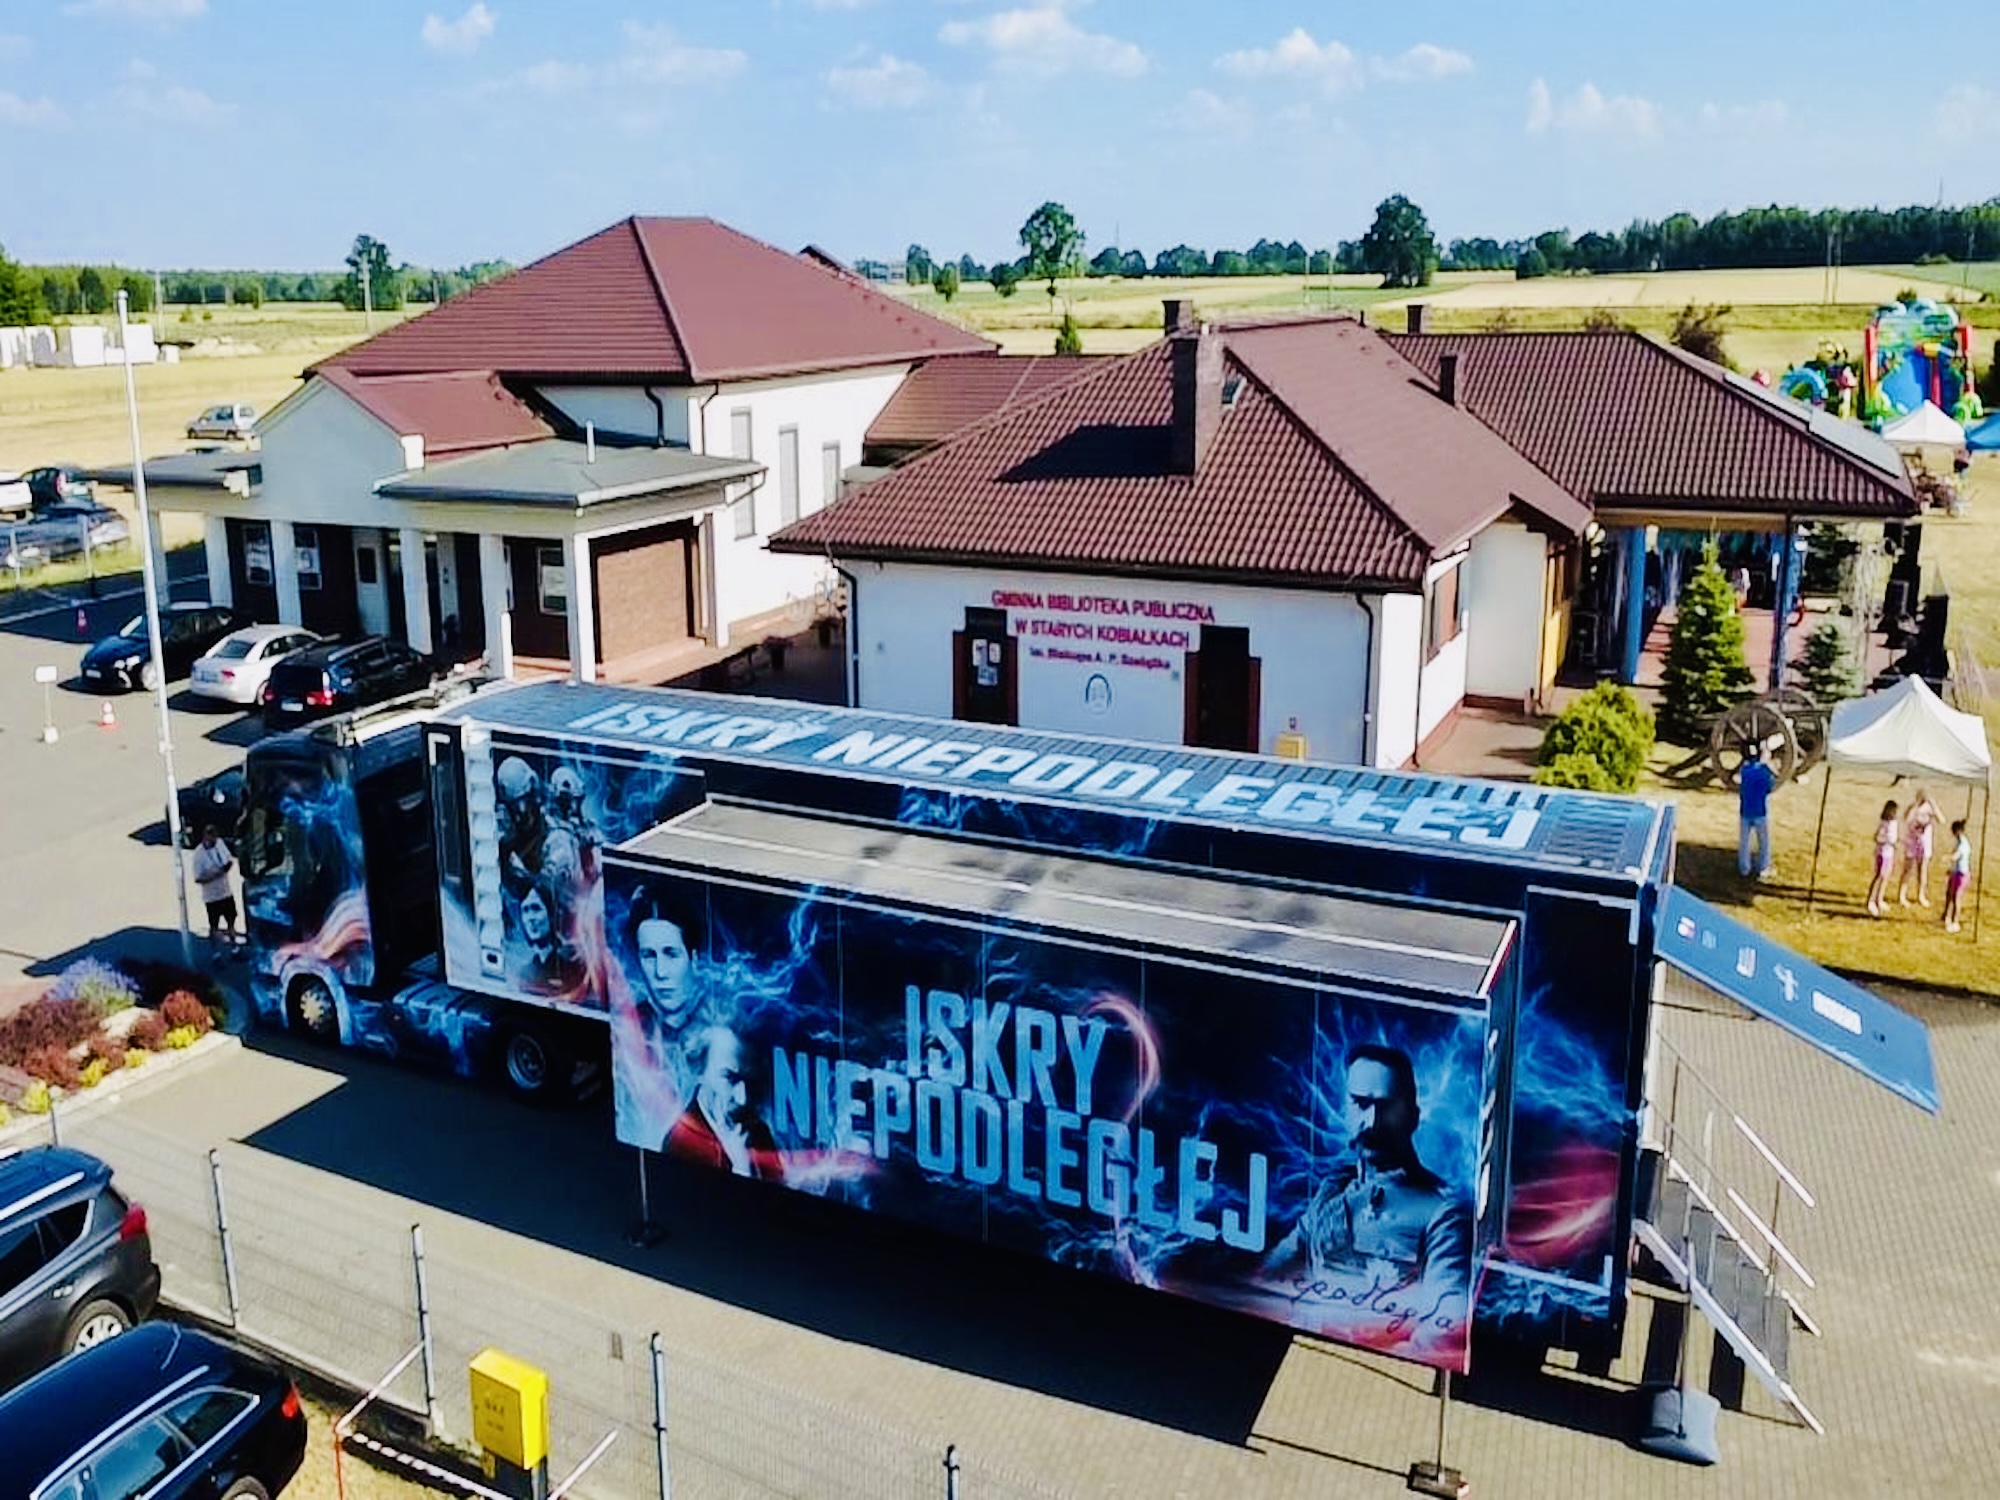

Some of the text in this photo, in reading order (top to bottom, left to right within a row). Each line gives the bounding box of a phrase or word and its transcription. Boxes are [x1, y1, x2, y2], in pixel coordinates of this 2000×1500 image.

[1016, 618, 1027, 634] W
[1132, 600, 1215, 624] PUBLICZNA
[567, 702, 1541, 850] ISKRY NIEPODLEGŁEJ
[904, 984, 1108, 1116] ISKRY
[773, 1046, 1268, 1253] NIEPODLEGŁEJ
